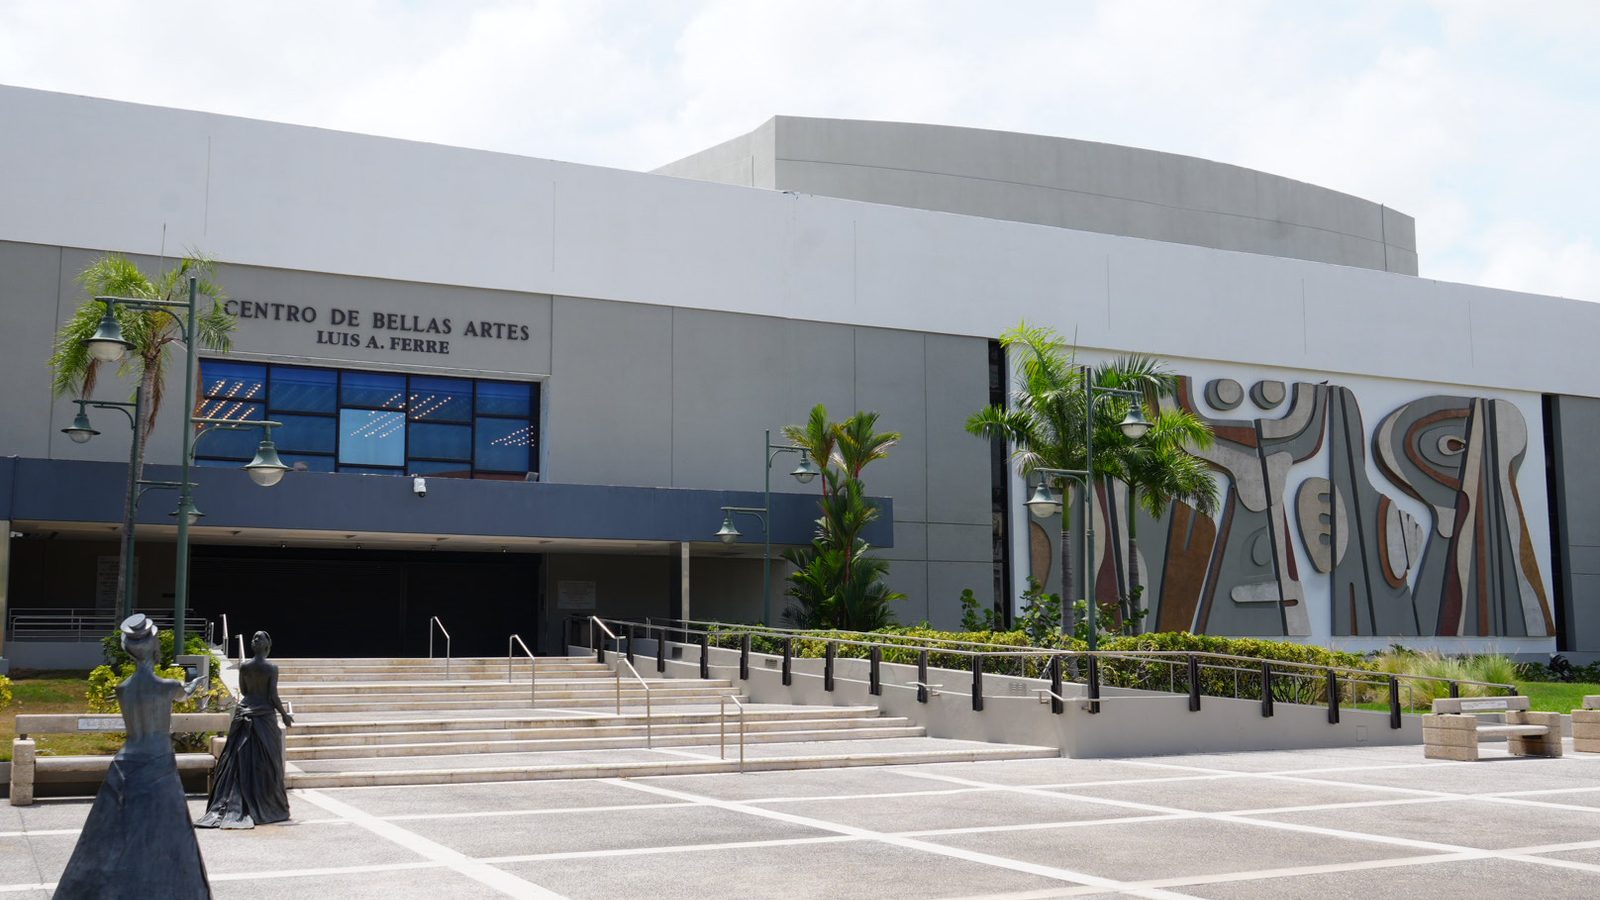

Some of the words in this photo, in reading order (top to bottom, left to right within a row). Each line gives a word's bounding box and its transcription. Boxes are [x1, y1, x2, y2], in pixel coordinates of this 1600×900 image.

[224, 299, 317, 323] CENTRO
[330, 308, 360, 327] DE
[372, 312, 452, 335] BELLAS
[464, 320, 530, 341] ARTES
[316, 329, 361, 347] LUIS
[365, 335, 385, 349] A.
[390, 336, 450, 355] FERRE
